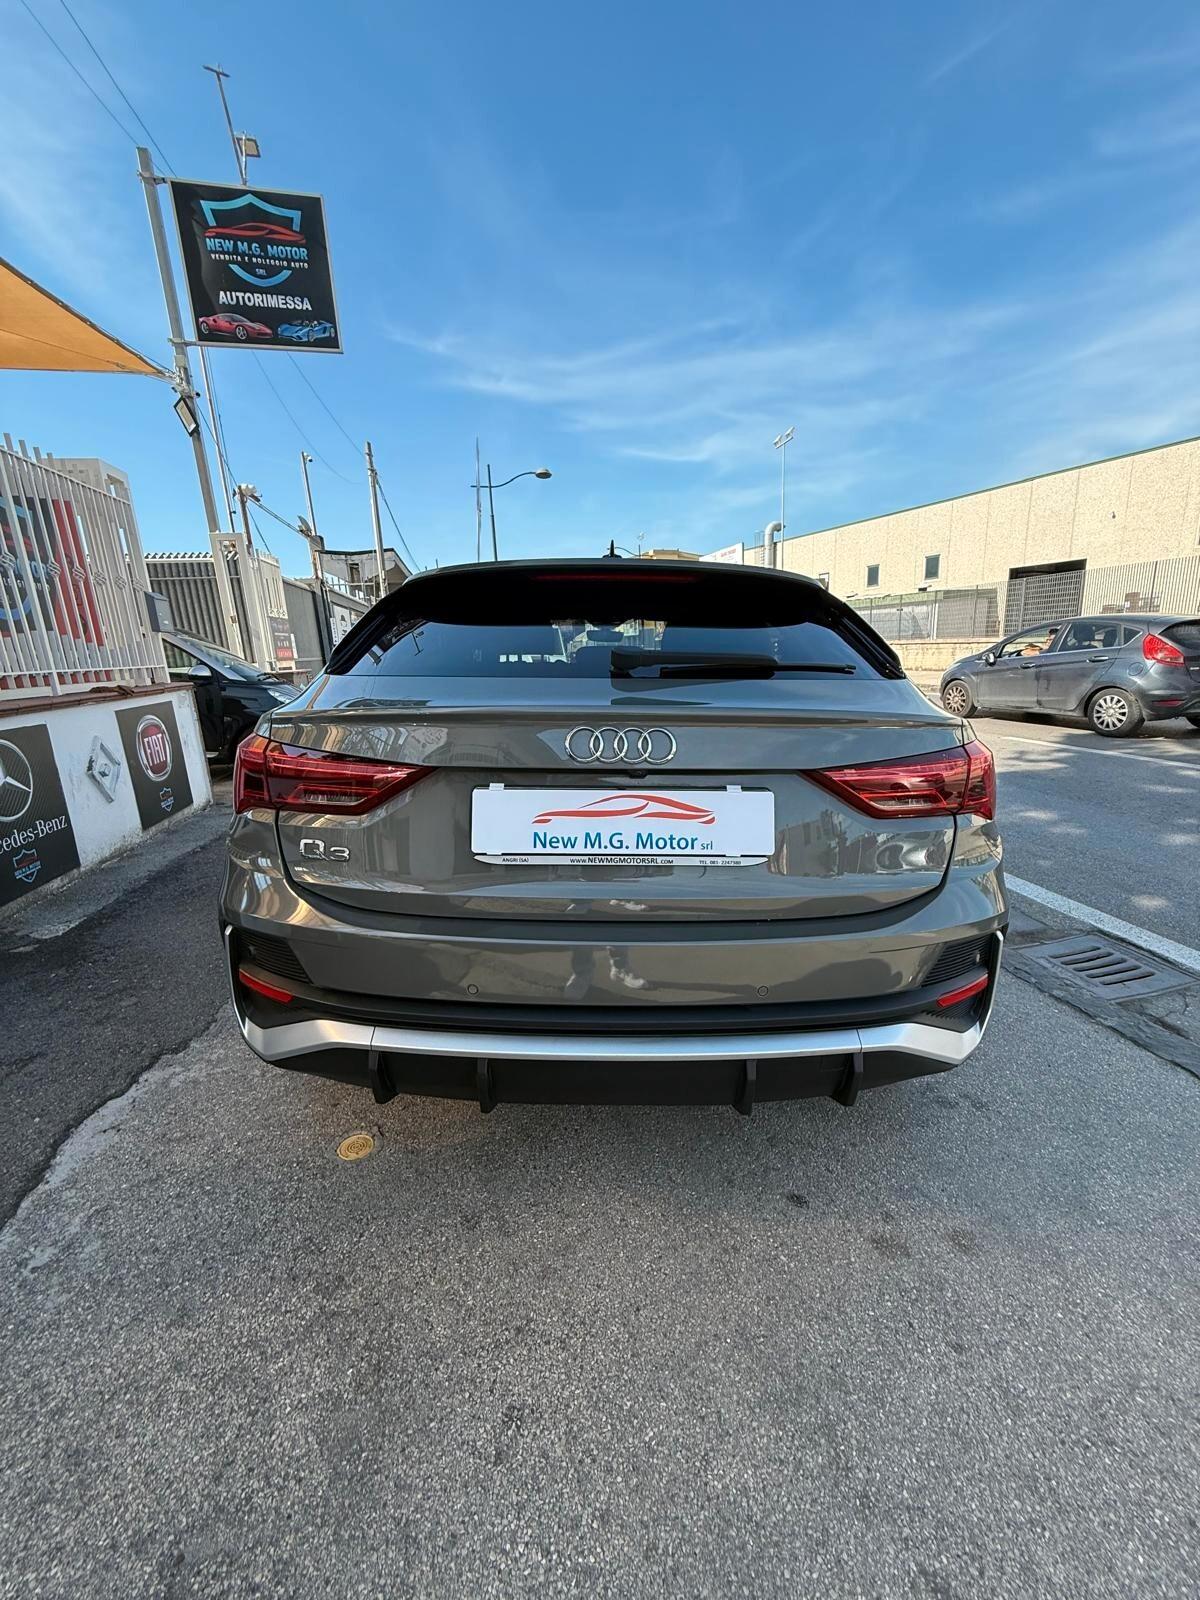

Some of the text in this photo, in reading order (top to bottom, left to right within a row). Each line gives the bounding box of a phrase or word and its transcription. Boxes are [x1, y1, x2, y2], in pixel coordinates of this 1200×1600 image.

[206, 238, 308, 260] NEW M.G. MOTOR
[211, 254, 242, 262] VENDITA
[252, 257, 288, 267] NOLEGGIO
[291, 261, 309, 269] AUTO
[255, 268, 267, 276] SRL
[219, 290, 312, 310] AUTORIMESSA
[143, 733, 166, 766] FIAT
[299, 838, 350, 861] Q3
[533, 831, 713, 850] New M.G. Motor srl
